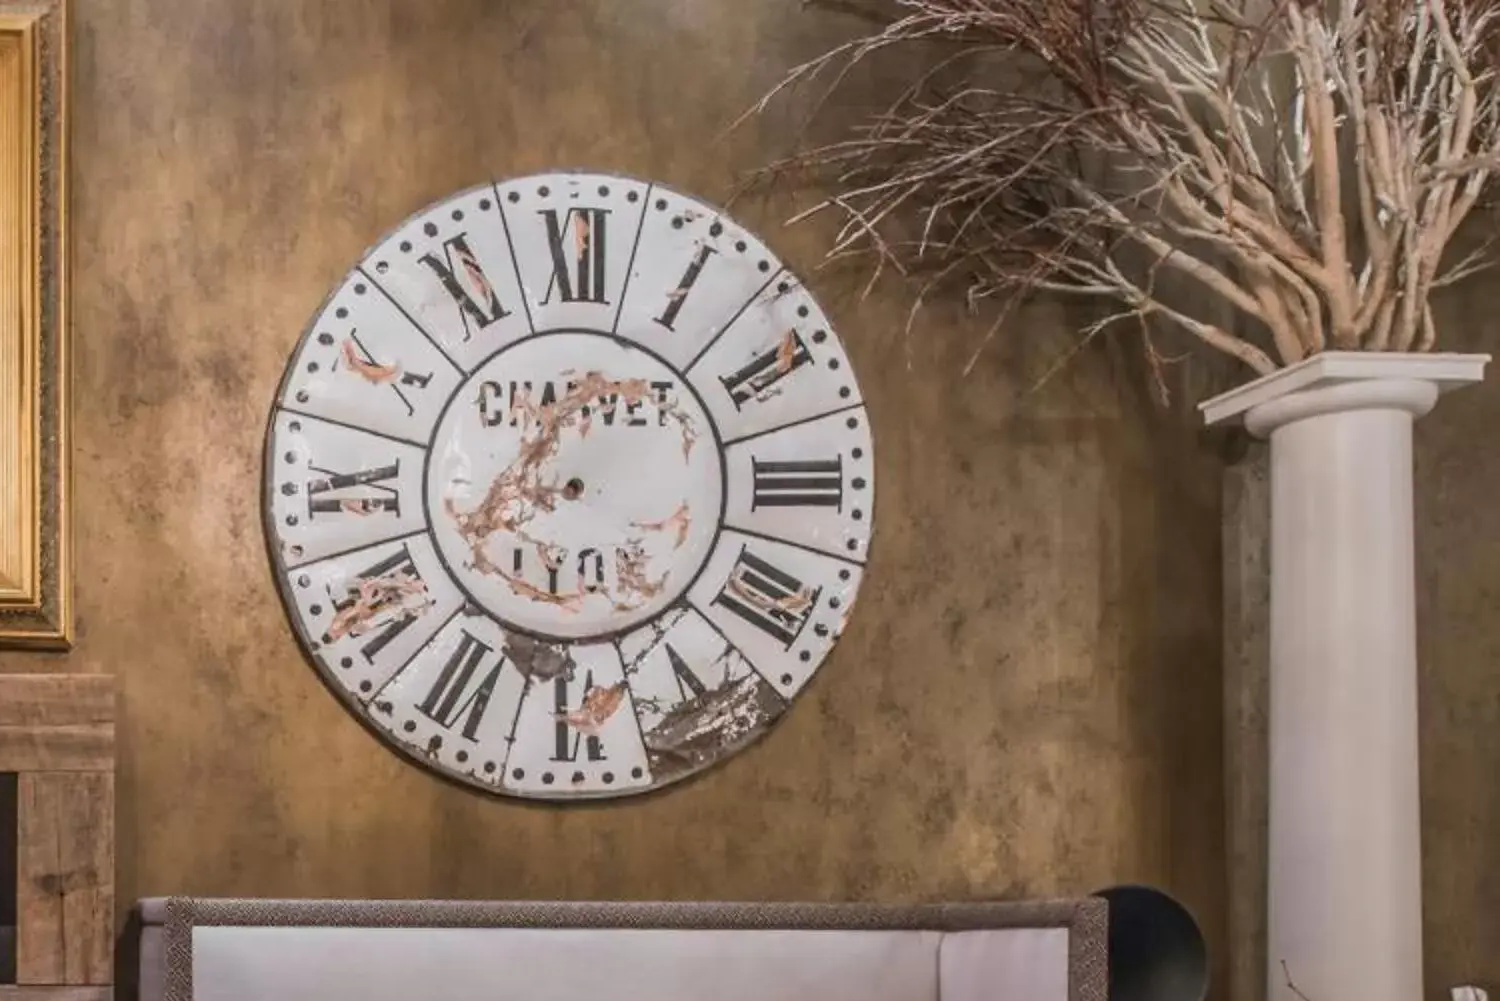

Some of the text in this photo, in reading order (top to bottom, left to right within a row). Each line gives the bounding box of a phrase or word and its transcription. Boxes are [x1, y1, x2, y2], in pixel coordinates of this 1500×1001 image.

[417, 231, 512, 342] XI
[537, 207, 613, 306] XII
[652, 245, 718, 332] I
[479, 380, 673, 427] CHAVET
[718, 328, 815, 413] II
[307, 457, 400, 519] IX
[751, 453, 843, 513] III
[513, 546, 646, 594] YO
[709, 543, 823, 653] IIII
[414, 627, 506, 743] VII
